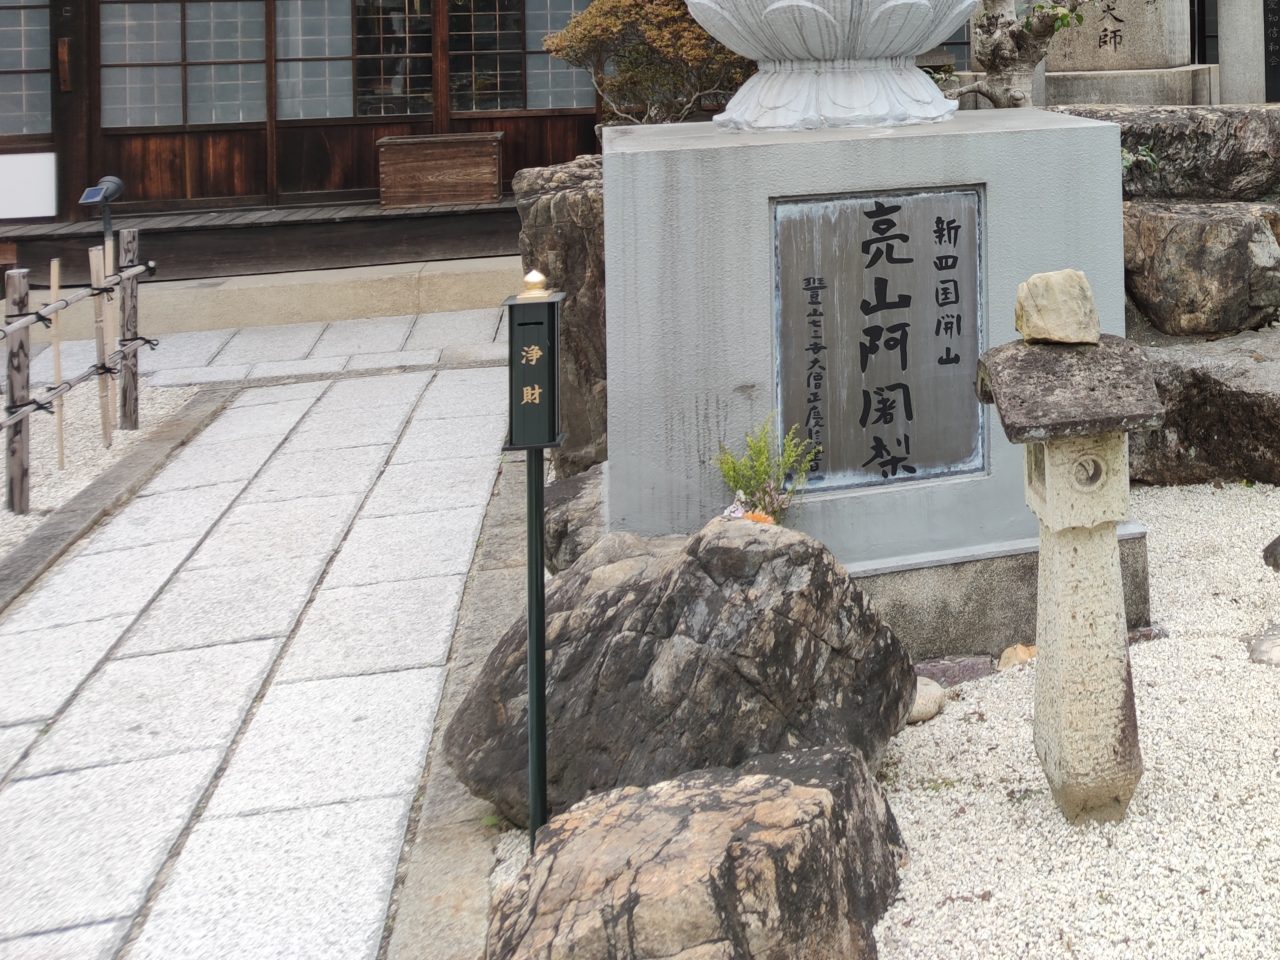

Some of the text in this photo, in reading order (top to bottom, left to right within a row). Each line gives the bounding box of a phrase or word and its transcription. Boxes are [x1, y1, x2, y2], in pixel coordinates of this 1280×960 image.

[932, 216, 961, 366] 新四国開山
[520, 344, 544, 405] 浄財
